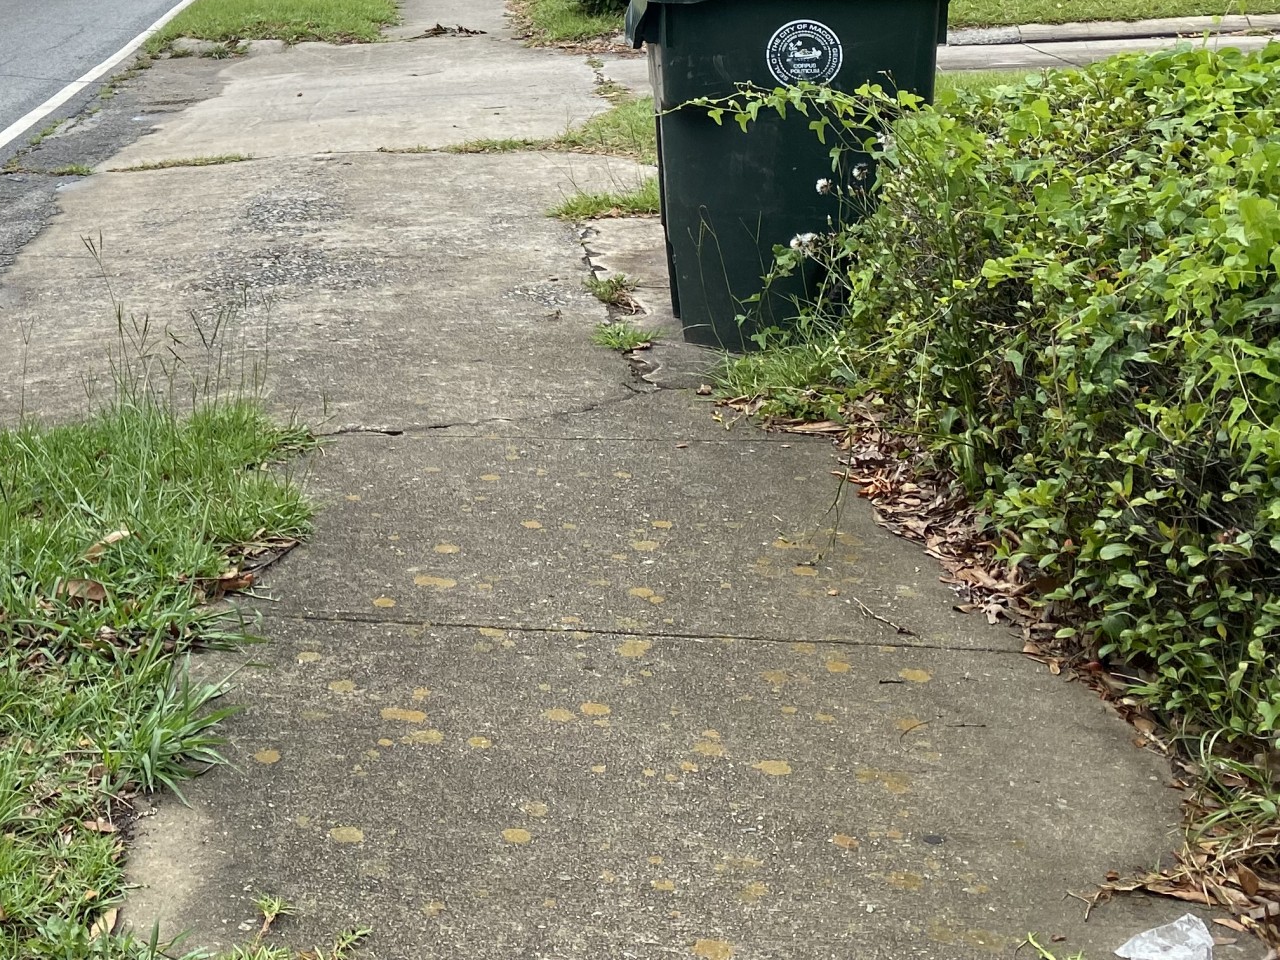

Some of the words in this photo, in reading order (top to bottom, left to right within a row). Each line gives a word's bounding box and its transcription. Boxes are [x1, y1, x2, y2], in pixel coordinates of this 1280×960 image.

[779, 26, 795, 38] CITY
[809, 24, 835, 45] MACON
[771, 38, 781, 51] THE
[771, 54, 777, 64] OF
[774, 65, 789, 81] SEAL
